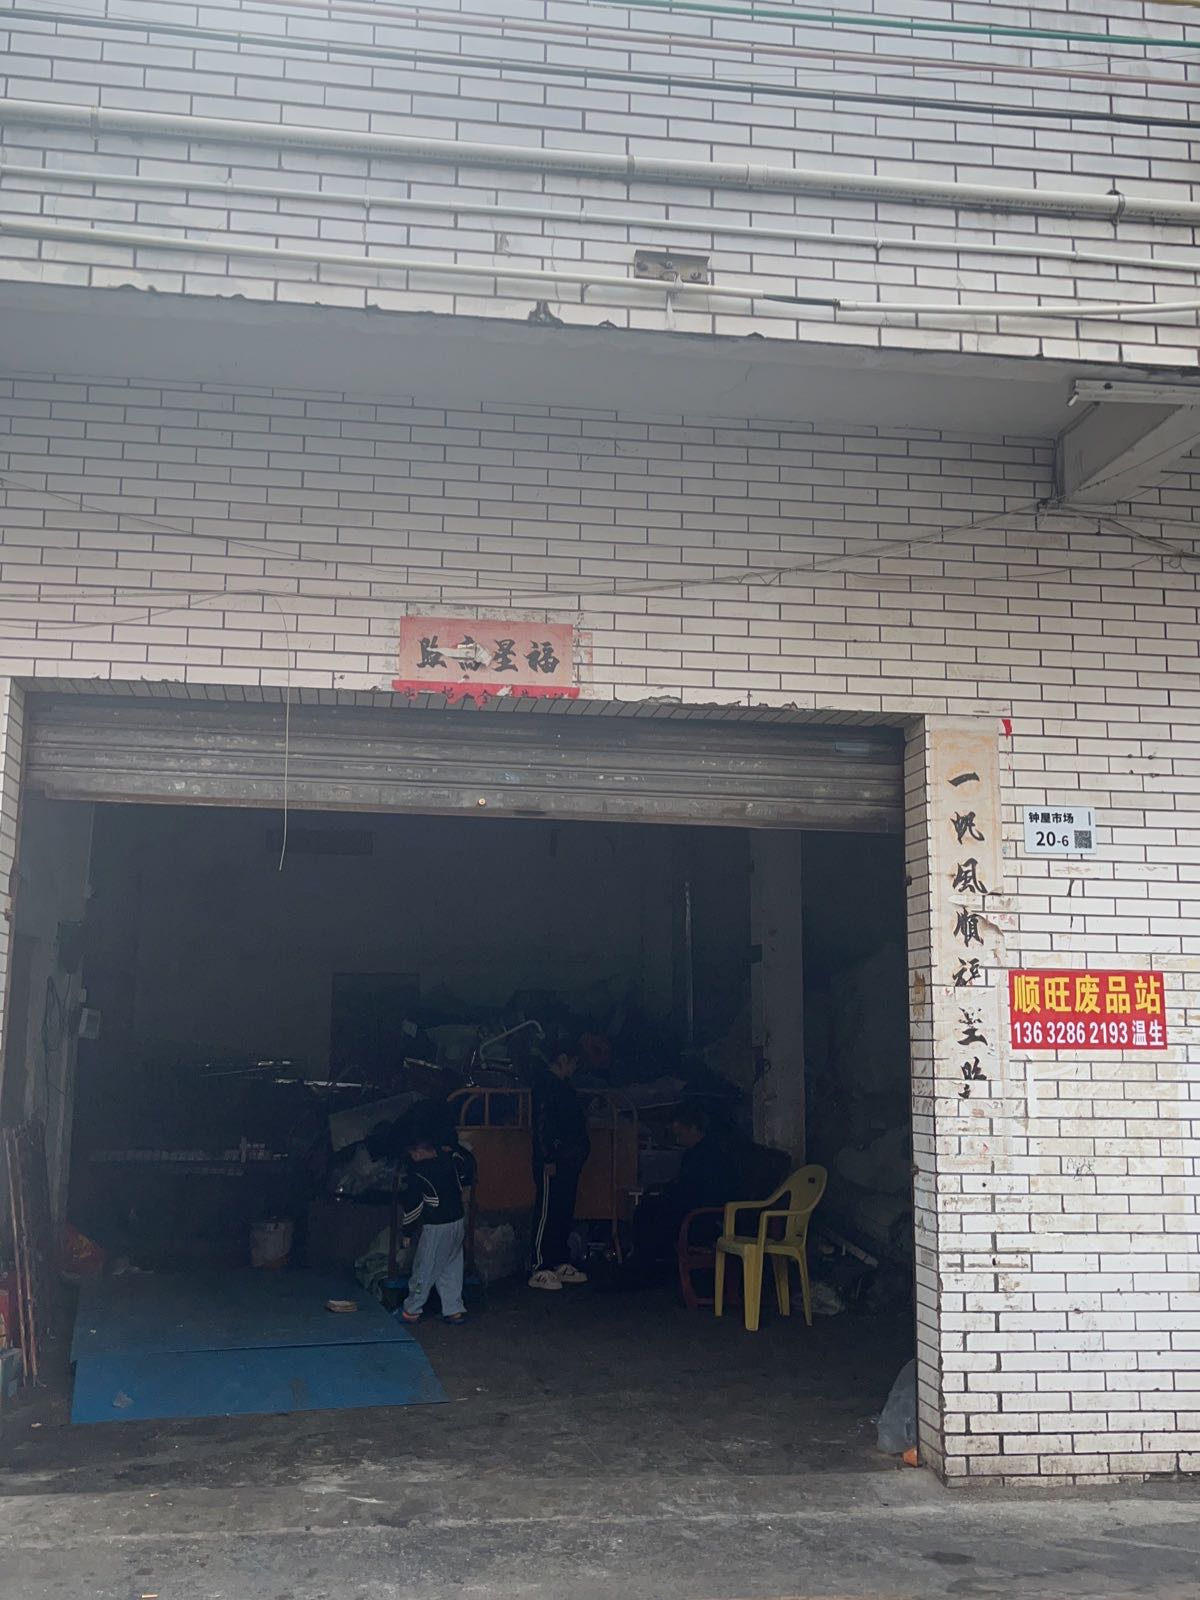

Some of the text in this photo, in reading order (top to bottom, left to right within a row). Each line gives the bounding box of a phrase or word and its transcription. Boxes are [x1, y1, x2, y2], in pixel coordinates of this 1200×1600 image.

[1028, 811, 1075, 824] 钟屋市场
[1035, 831, 1070, 847] 20-6
[1013, 974, 1161, 1015] 顺旺废品站
[1014, 1019, 1164, 1046] 136 3286 2193 温生
